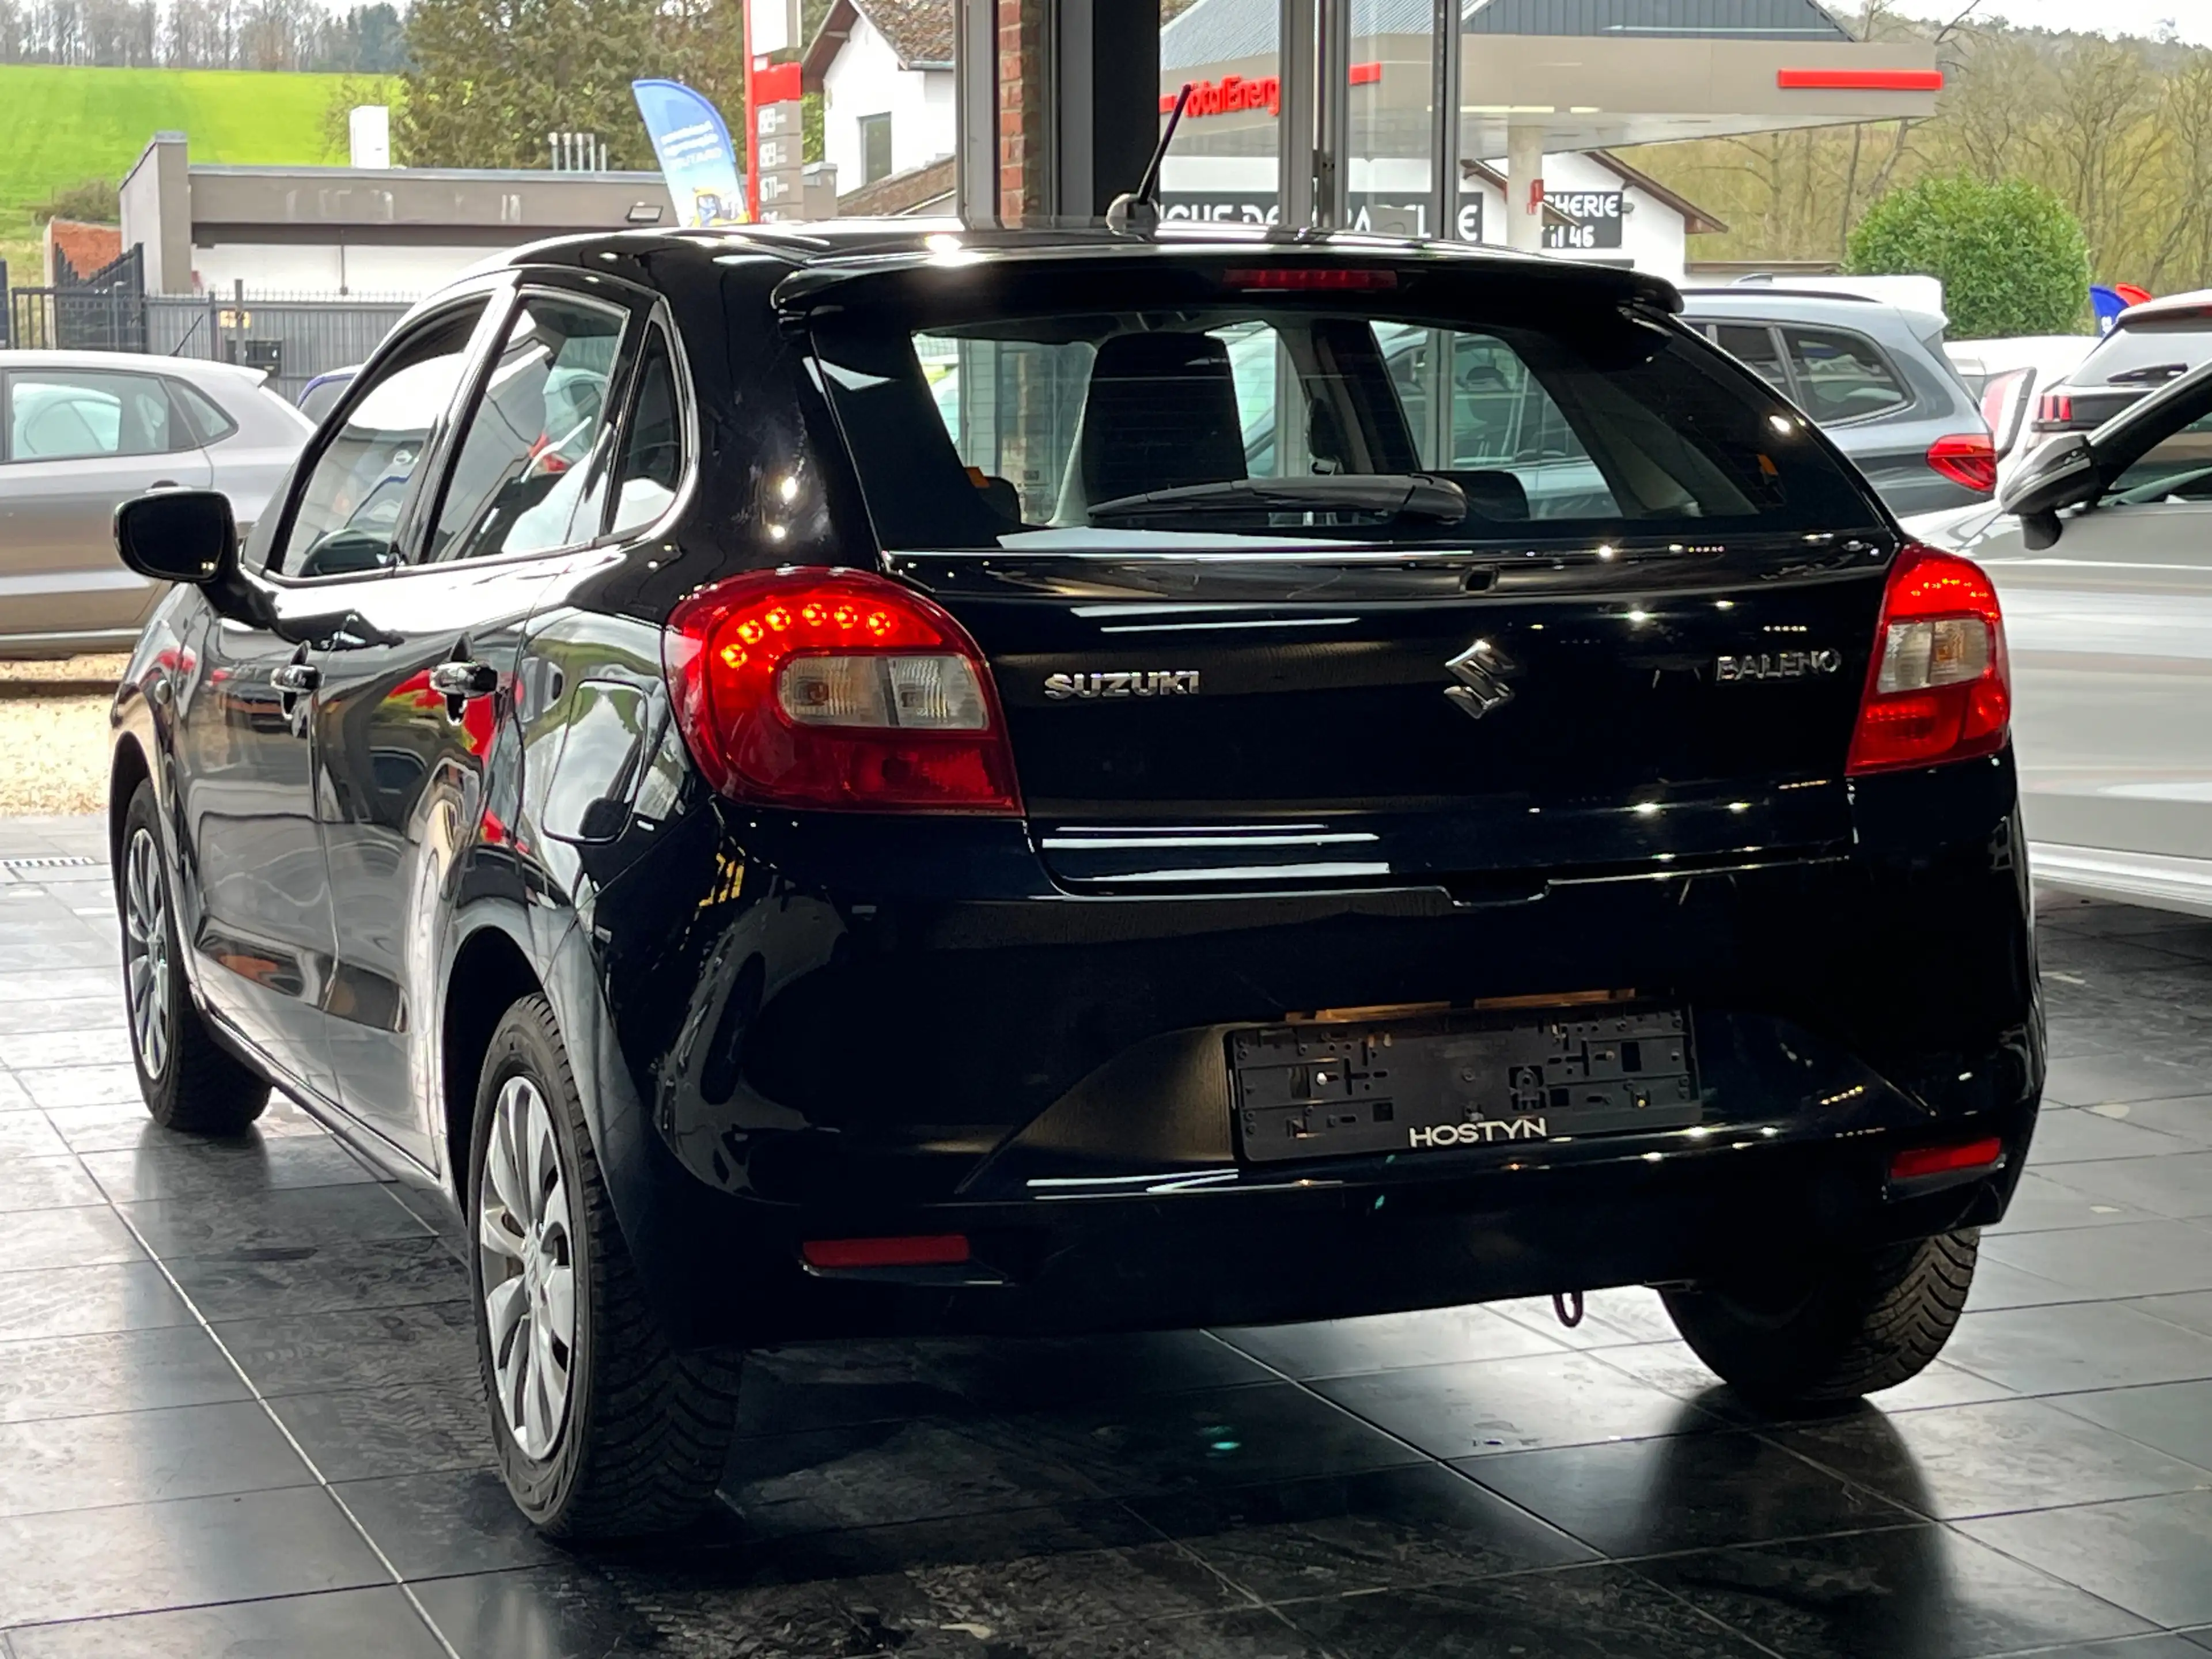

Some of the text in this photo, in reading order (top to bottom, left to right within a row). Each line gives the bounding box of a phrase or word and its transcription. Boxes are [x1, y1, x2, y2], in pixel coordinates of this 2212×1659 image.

[1569, 225, 1595, 248] 46
[1717, 648, 1842, 681] BALENO
[1044, 671, 1199, 699] SUZUKI
[1409, 1118, 1547, 1147] HOSTYN
